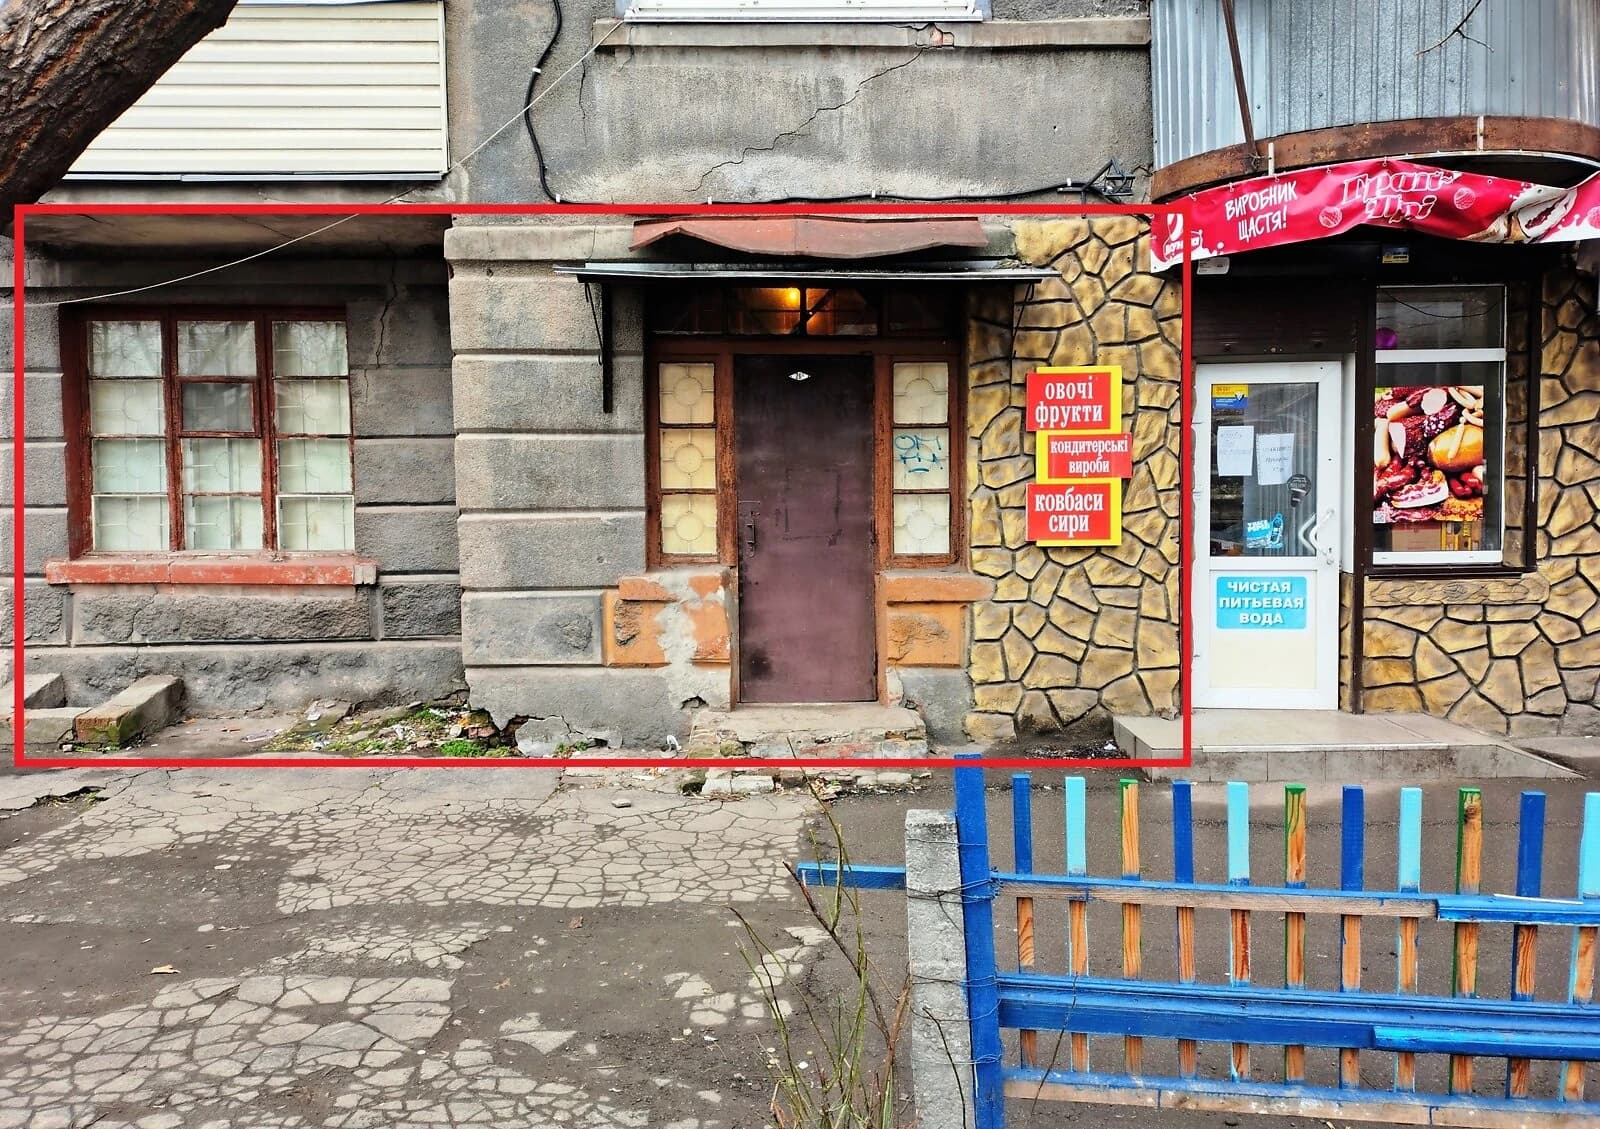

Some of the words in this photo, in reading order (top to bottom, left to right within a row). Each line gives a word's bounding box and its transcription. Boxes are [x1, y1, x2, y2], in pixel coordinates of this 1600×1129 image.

[1224, 180, 1298, 221] ВИРОБНИК
[1238, 205, 1287, 243] ЩАСТЯ!
[1045, 376, 1094, 400] овочі
[1035, 401, 1103, 428] фрукти
[1050, 435, 1128, 456] кондитерські
[1068, 456, 1110, 477] вироби
[1035, 487, 1104, 511] ковбаси
[1049, 514, 1090, 537] сири
[1227, 581, 1291, 593] ЧИСТАЯ
[1219, 597, 1304, 609] ПИТЬЕВАЯ
[1239, 613, 1284, 626] ВОДА
